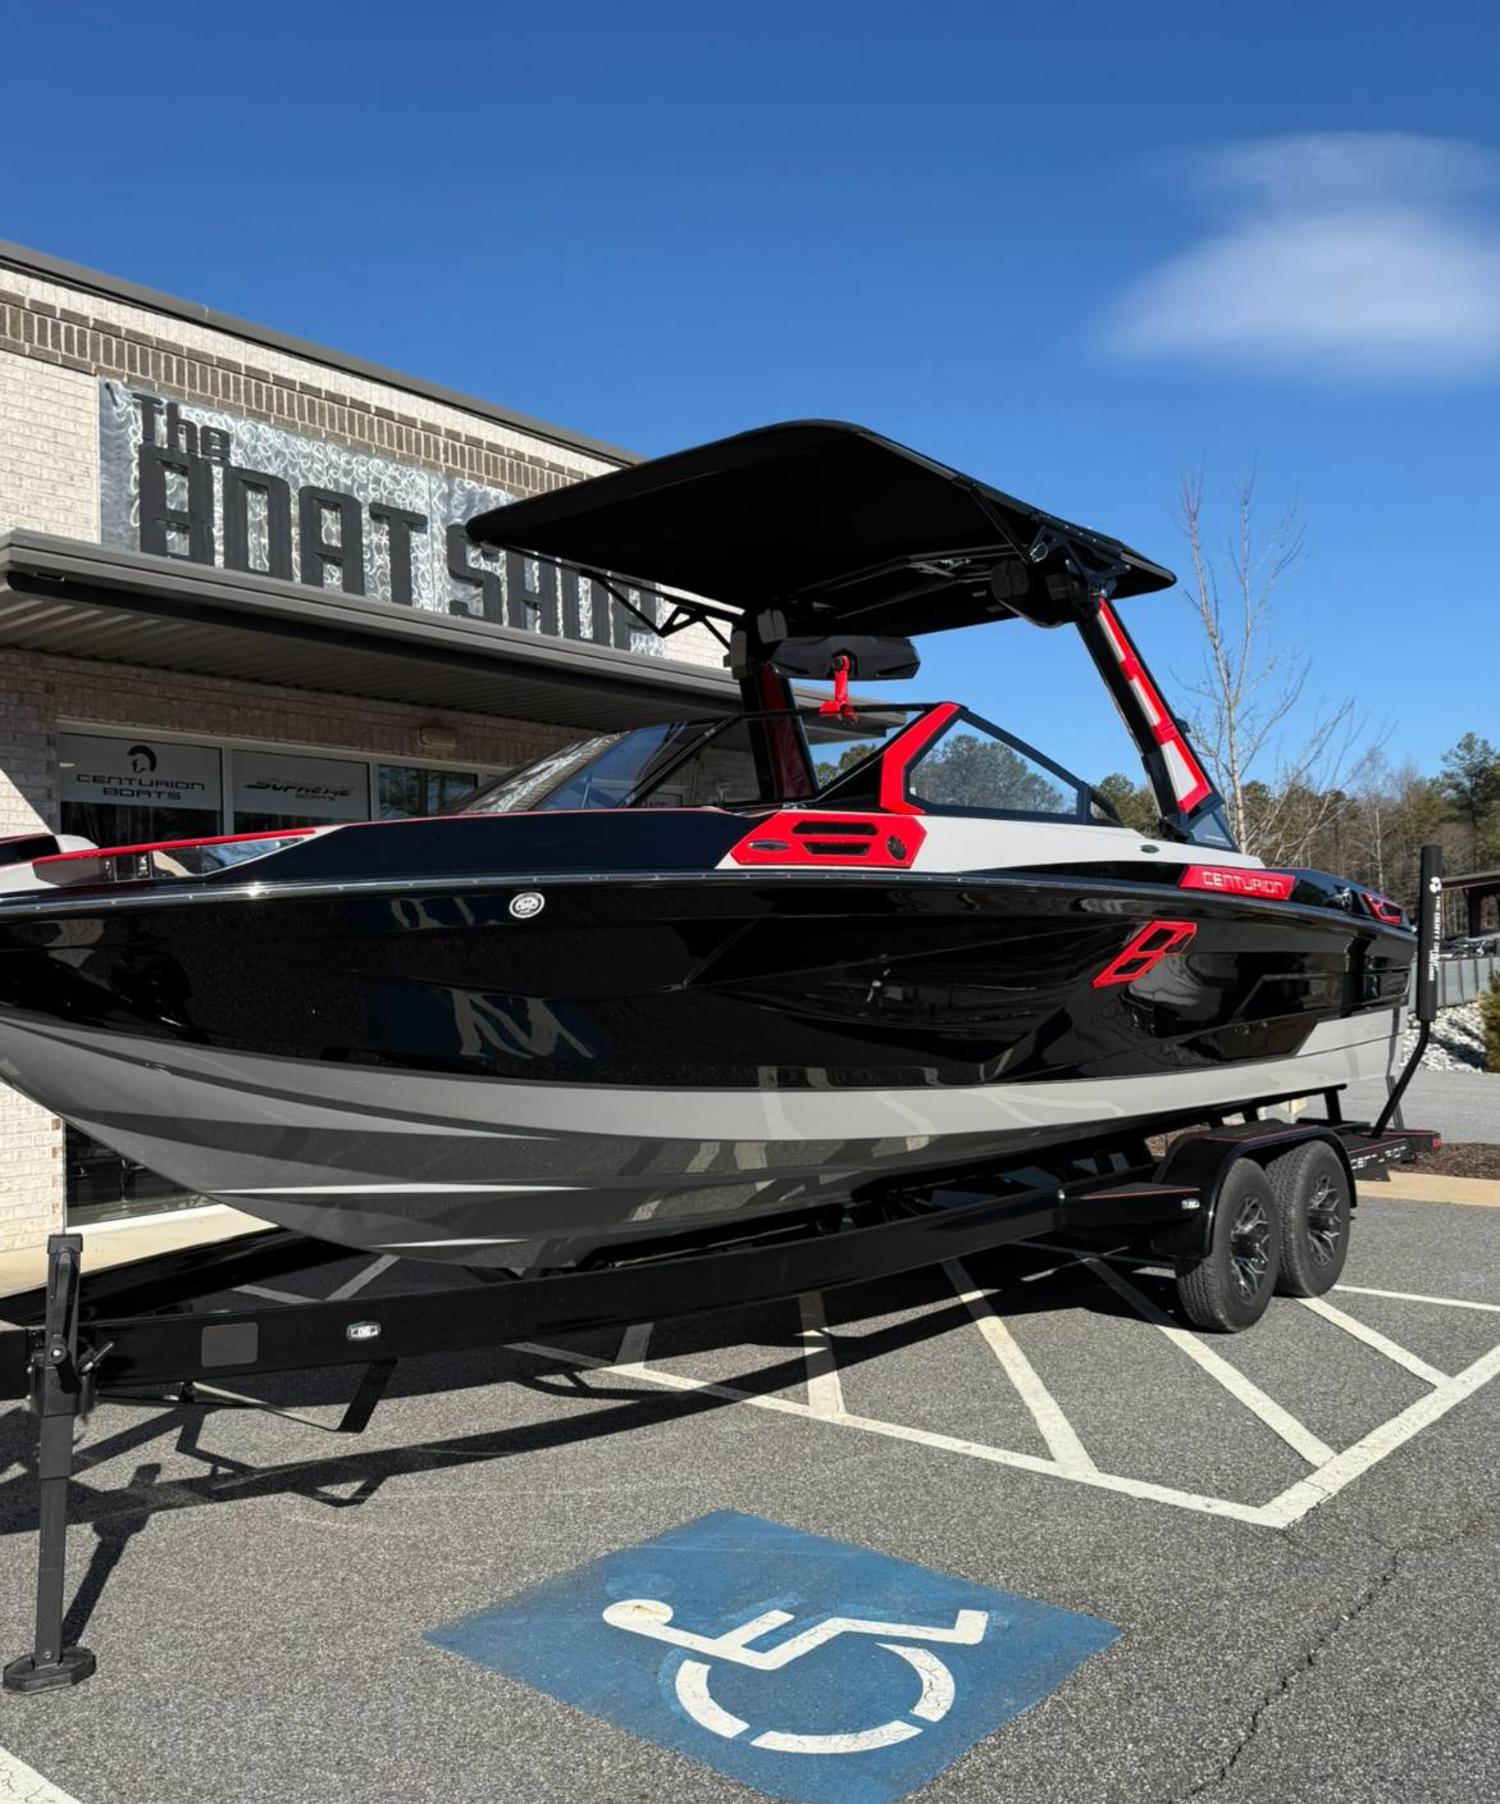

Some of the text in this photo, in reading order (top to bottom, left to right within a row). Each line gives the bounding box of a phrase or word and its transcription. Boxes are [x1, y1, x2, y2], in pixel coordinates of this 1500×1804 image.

[132, 392, 230, 459] The
[138, 444, 429, 607] BOAT
[76, 773, 206, 791] CENTURION
[103, 787, 182, 800] BOATS
[1201, 871, 1286, 896] CENTURION
